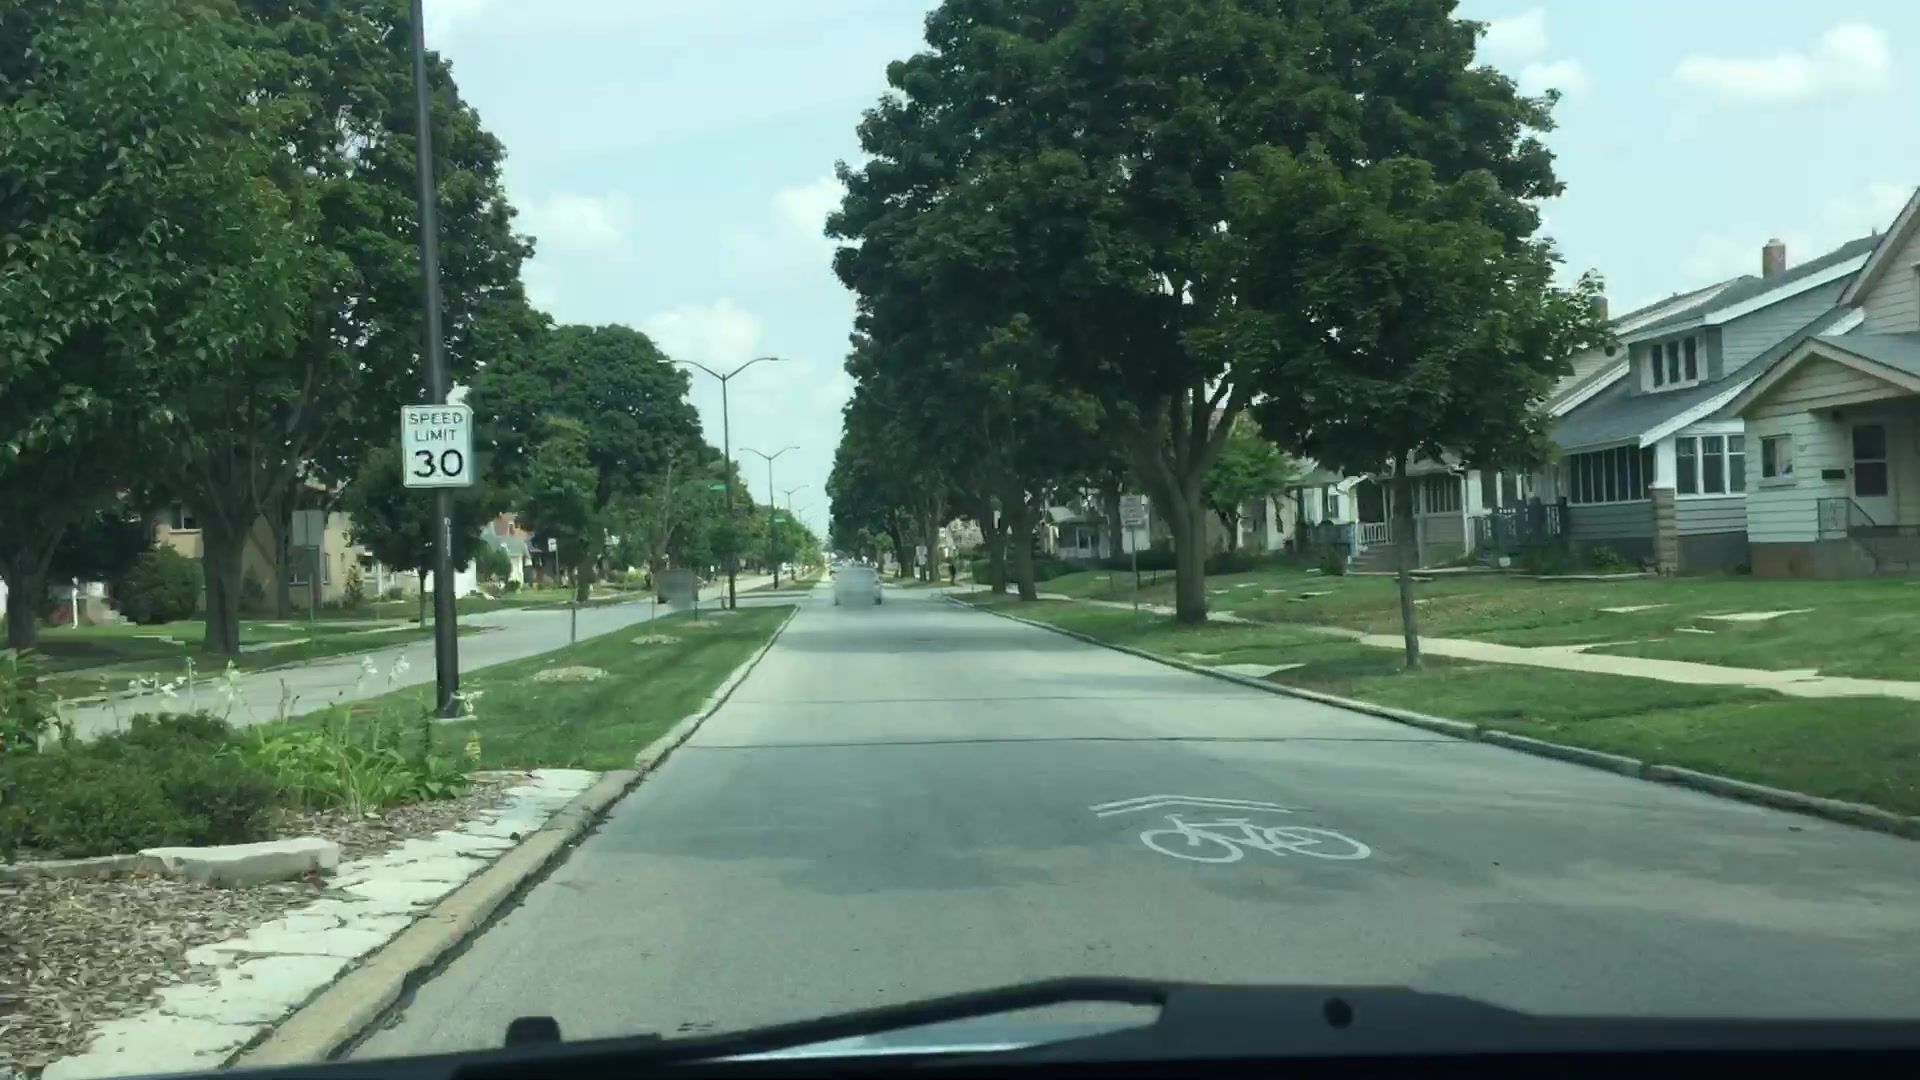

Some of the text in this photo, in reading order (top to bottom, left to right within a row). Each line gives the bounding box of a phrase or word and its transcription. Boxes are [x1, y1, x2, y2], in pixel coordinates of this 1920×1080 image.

[409, 412, 463, 424] SPEED
[415, 429, 457, 441] LIMIT
[414, 449, 464, 477] 30
